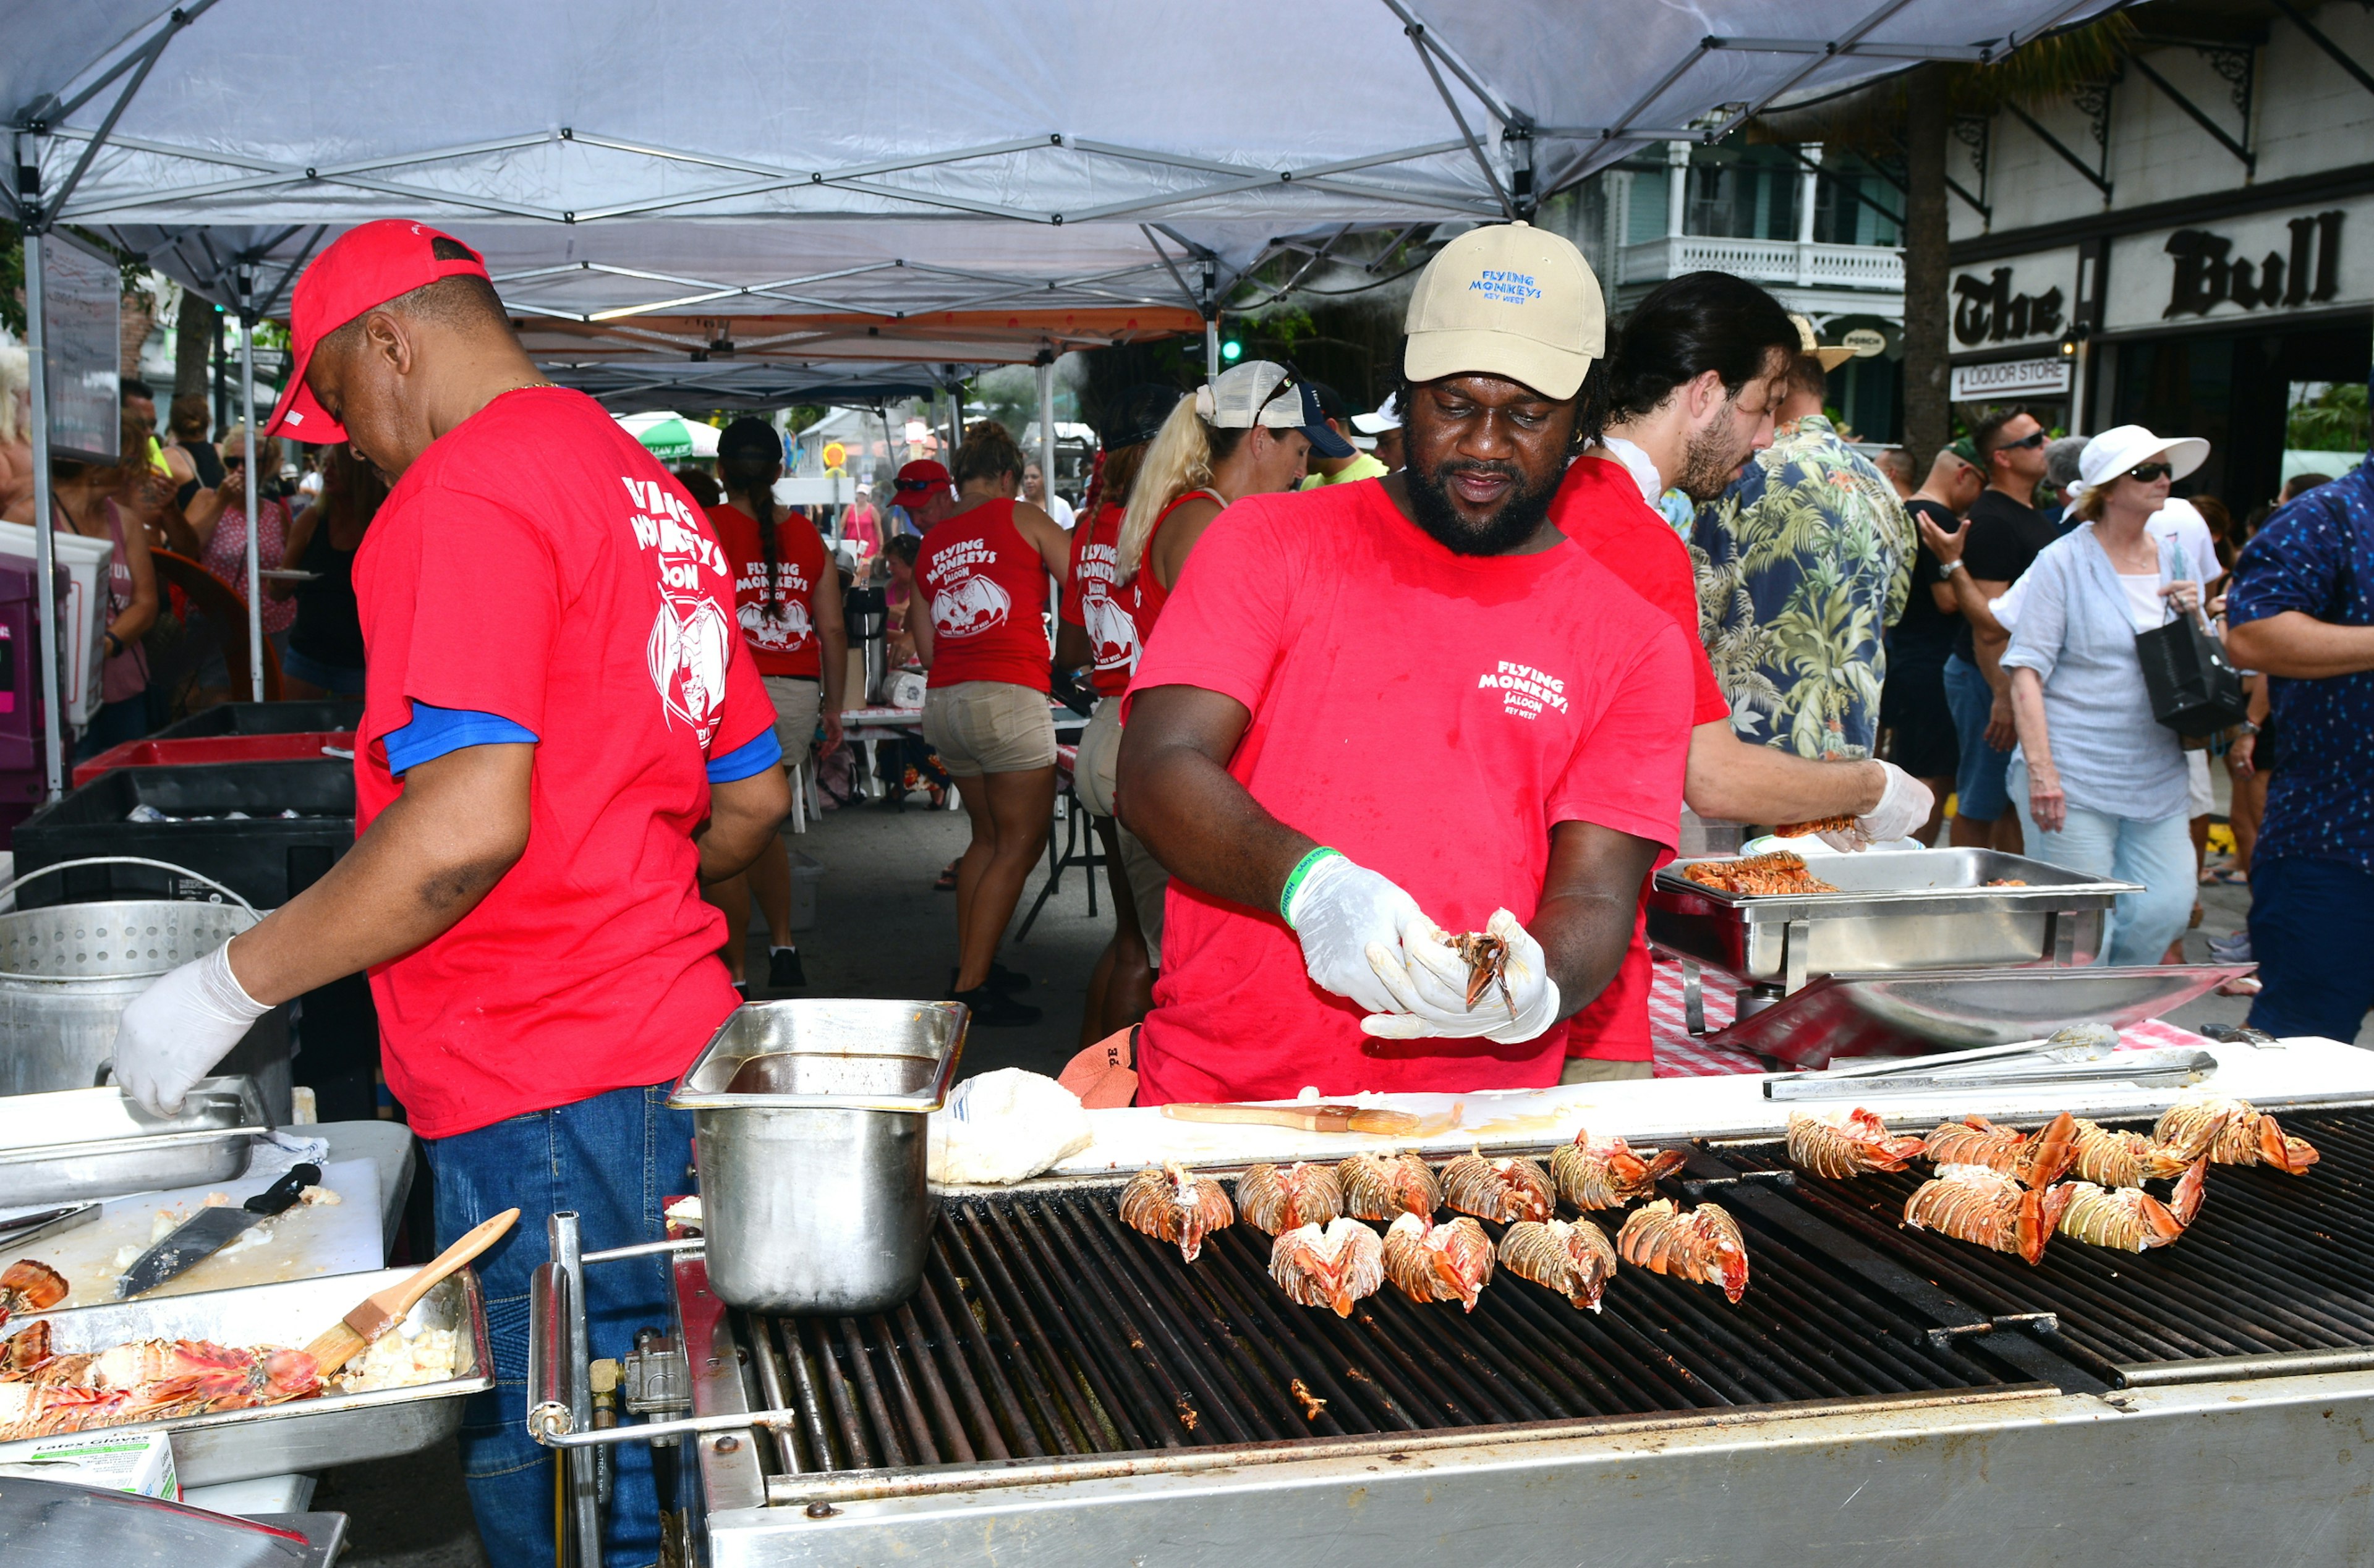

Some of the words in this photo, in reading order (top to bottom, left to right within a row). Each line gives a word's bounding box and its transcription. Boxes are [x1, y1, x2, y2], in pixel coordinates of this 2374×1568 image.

[1483, 271, 1534, 286] FLYING
[1952, 266, 2064, 345] The
[2163, 210, 2346, 319] Bull
[1469, 281, 1541, 299] MONKEYS
[1503, 296, 1525, 305] WEST
[1970, 365, 2015, 386] LIQUOR
[2019, 360, 2062, 381] STORE
[932, 538, 984, 566] FLYING
[746, 562, 799, 575] FLYNG
[926, 550, 997, 585] MONKEYS
[943, 567, 970, 585] SALOON
[1498, 660, 1565, 693] FLYING
[1478, 674, 1568, 714] MONKEYS
[1504, 691, 1543, 713] SALOON
[1504, 706, 1518, 715] KEY
[1518, 709, 1537, 720] WEST
[1298, 857, 1313, 873] Keys
[36, 1441, 84, 1451] Latex
[90, 1435, 150, 1445] Gloves
